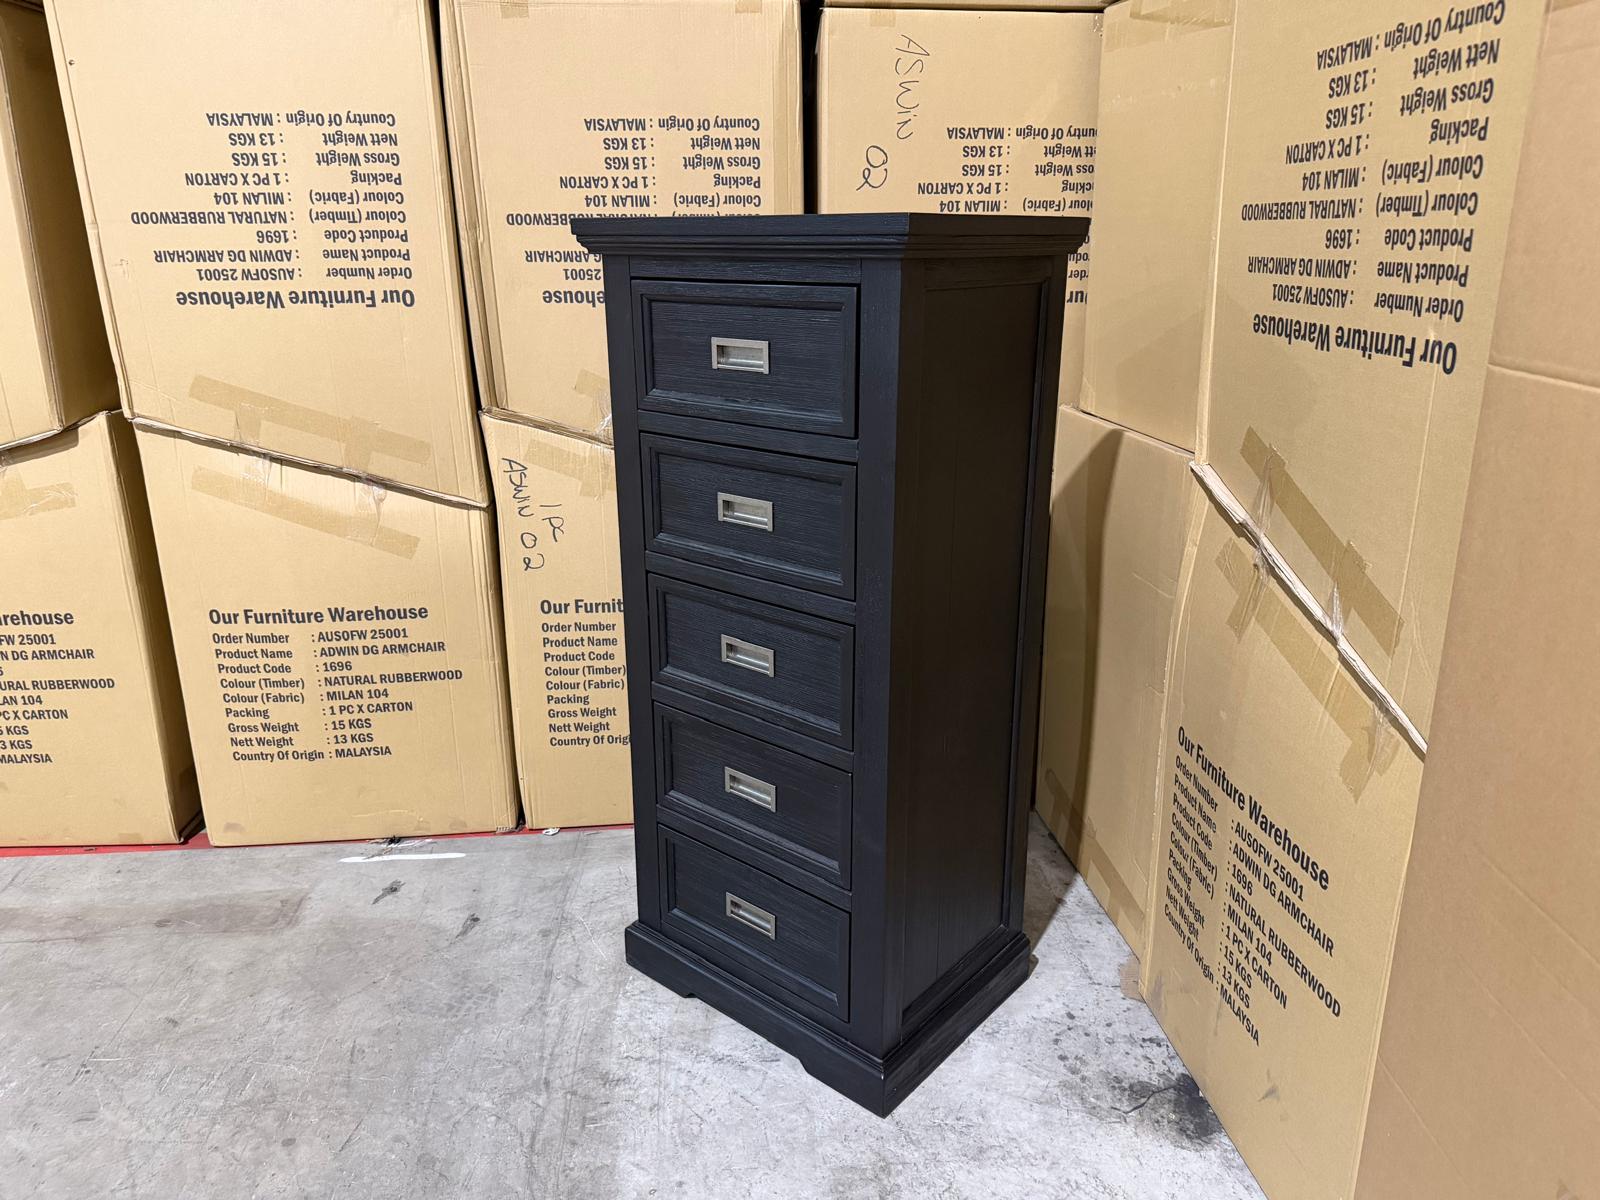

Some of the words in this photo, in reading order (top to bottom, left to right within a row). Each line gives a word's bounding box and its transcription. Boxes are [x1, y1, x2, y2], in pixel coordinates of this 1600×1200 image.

[1444, 0, 1506, 34] Country
[1384, 22, 1422, 52] Origin
[1424, 17, 1441, 44] Of
[1317, 36, 1373, 70] MALAYSIA
[1450, 78, 1494, 104] Gross
[1400, 86, 1447, 116] Weight
[206, 112, 273, 126] MALAYSIA
[285, 113, 325, 127] Origin
[328, 113, 342, 126] Of
[345, 110, 395, 127] Country
[1325, 106, 1348, 129] KGS
[1350, 102, 1366, 125] 15
[583, 118, 646, 131] MALAYSIA
[658, 117, 694, 132] Origin
[697, 118, 711, 131] Of
[713, 115, 760, 131] Country
[228, 132, 256, 146] KGS
[259, 132, 276, 146] 13
[322, 131, 368, 146] Weight
[370, 132, 398, 146] Nett
[962, 145, 986, 157] KGS
[989, 145, 1003, 157] 13
[1043, 145, 1082, 158] Weight
[1382, 154, 1433, 184] (Fabric)
[1435, 154, 1484, 180] Colour
[184, 172, 238, 186] CARTON
[241, 172, 250, 185] X
[255, 172, 271, 186] PC
[275, 172, 282, 185] 1
[350, 170, 402, 185] Packing
[559, 176, 609, 189] CARTON
[610, 176, 620, 188] X
[622, 176, 639, 189] PC
[641, 176, 648, 188] 1
[713, 173, 761, 188] Packing
[1302, 171, 1321, 191] 104
[1323, 166, 1360, 190] MILAN
[213, 192, 239, 205] 104
[243, 192, 285, 205] MILAN
[309, 189, 360, 205] (Fabric)
[362, 192, 405, 205] Colour
[584, 194, 608, 207] 104
[611, 194, 650, 207] MILAN
[673, 193, 720, 208] (Fabric)
[723, 194, 762, 207] Colour
[1022, 197, 1066, 212] (Fabric)
[1376, 189, 1429, 217] (Timber)
[1431, 192, 1479, 216] Colour
[939, 200, 961, 212] 104
[965, 200, 1001, 212] MILAN
[1241, 201, 1305, 221] RUBBERWOOD
[1309, 198, 1356, 219] NATURAL
[131, 211, 225, 225] RUBBERWOOD
[228, 211, 288, 224] NATURAL
[309, 210, 362, 224] (Timber)
[364, 210, 406, 224] Colour
[1325, 228, 1353, 250] 1696
[1384, 228, 1416, 251] Code
[1419, 228, 1474, 251] Product
[154, 250, 224, 263] ARMCHAIR
[227, 250, 247, 263] DG
[250, 250, 293, 262] ADWIN
[323, 249, 359, 261] Name
[362, 248, 411, 261] Product
[1248, 255, 1297, 275] ARMCHAIR
[1299, 258, 1312, 277] DG
[1314, 259, 1352, 279] ADWIN
[1377, 261, 1411, 284] Name
[196, 268, 238, 281] 25001
[241, 268, 296, 281] AUSOFW
[325, 267, 375, 280] Number
[377, 267, 412, 280] Order
[1415, 262, 1469, 288] Product
[175, 290, 286, 309] Warehouse
[288, 289, 377, 308] Furniture
[381, 289, 415, 308] Our
[1272, 283, 1302, 303] 25001
[1303, 290, 1349, 308] AUSOFW
[1374, 292, 1423, 318] Number
[1425, 298, 1464, 323] Order
[1253, 313, 1330, 352] Warehouse
[1335, 327, 1417, 368] Furniture
[1419, 338, 1457, 375] Our
[208, 609, 240, 625] Our
[243, 607, 325, 625] Furniture
[328, 605, 429, 623] Warehouse
[541, 622, 572, 633] Order
[574, 622, 616, 632] Number
[212, 633, 244, 644] Order
[245, 632, 290, 644] Number
[317, 630, 368, 643] AUSOFW
[370, 628, 409, 640] 25001
[543, 636, 585, 648] Product
[587, 636, 618, 647] Name
[12, 650, 29, 661] DG
[31, 649, 95, 661] ARMCHAIR
[215, 648, 258, 660] Product
[261, 648, 293, 659] Name
[319, 646, 359, 658] ADWIN
[362, 645, 379, 656] DG
[381, 642, 446, 655] ARMCHAIR
[217, 663, 261, 675] Product
[263, 662, 292, 674] Code
[323, 661, 353, 672] 1696
[544, 666, 580, 677] Colour
[582, 665, 626, 676] (Timber)
[32, 678, 115, 690] RUBBERWOOD
[220, 679, 257, 689] Colour
[258, 677, 305, 690] (Timber)
[324, 674, 378, 687] NATURAL
[379, 670, 463, 684] RUBBERWOOD
[222, 693, 259, 704] Colour
[261, 692, 305, 704] (Fabric)
[326, 690, 364, 701] MILAN
[367, 688, 389, 699] 104
[547, 694, 590, 705] Packing
[13, 710, 21, 721] X
[23, 709, 69, 720] CARTON
[225, 707, 270, 720] Packing
[329, 705, 336, 716] 1
[339, 704, 355, 715] PC
[356, 704, 365, 714] X
[366, 701, 414, 713] CARTON
[548, 723, 572, 733] Nett
[573, 721, 611, 733] Weight
[232, 751, 275, 763] Country
[277, 750, 289, 760] Of
[292, 749, 325, 761] Origin
[335, 746, 392, 758] MALAYSIA
[1178, 726, 1195, 757] Our
[1195, 744, 1246, 811] Furniture
[1249, 795, 1329, 890] Warehouse
[1175, 755, 1192, 783] Order
[1193, 774, 1218, 812] Number
[1234, 821, 1273, 867] AUSOFW
[1273, 858, 1304, 901] 25001
[1173, 792, 1196, 831] Product
[1196, 824, 1213, 850] Code
[1231, 864, 1253, 896] 1696
[1174, 774, 1198, 811] Product
[1198, 803, 1217, 834] Name
[1232, 843, 1262, 882] ADWIN
[1263, 875, 1276, 898] DG
[1277, 890, 1335, 958] ARMCHAIR
